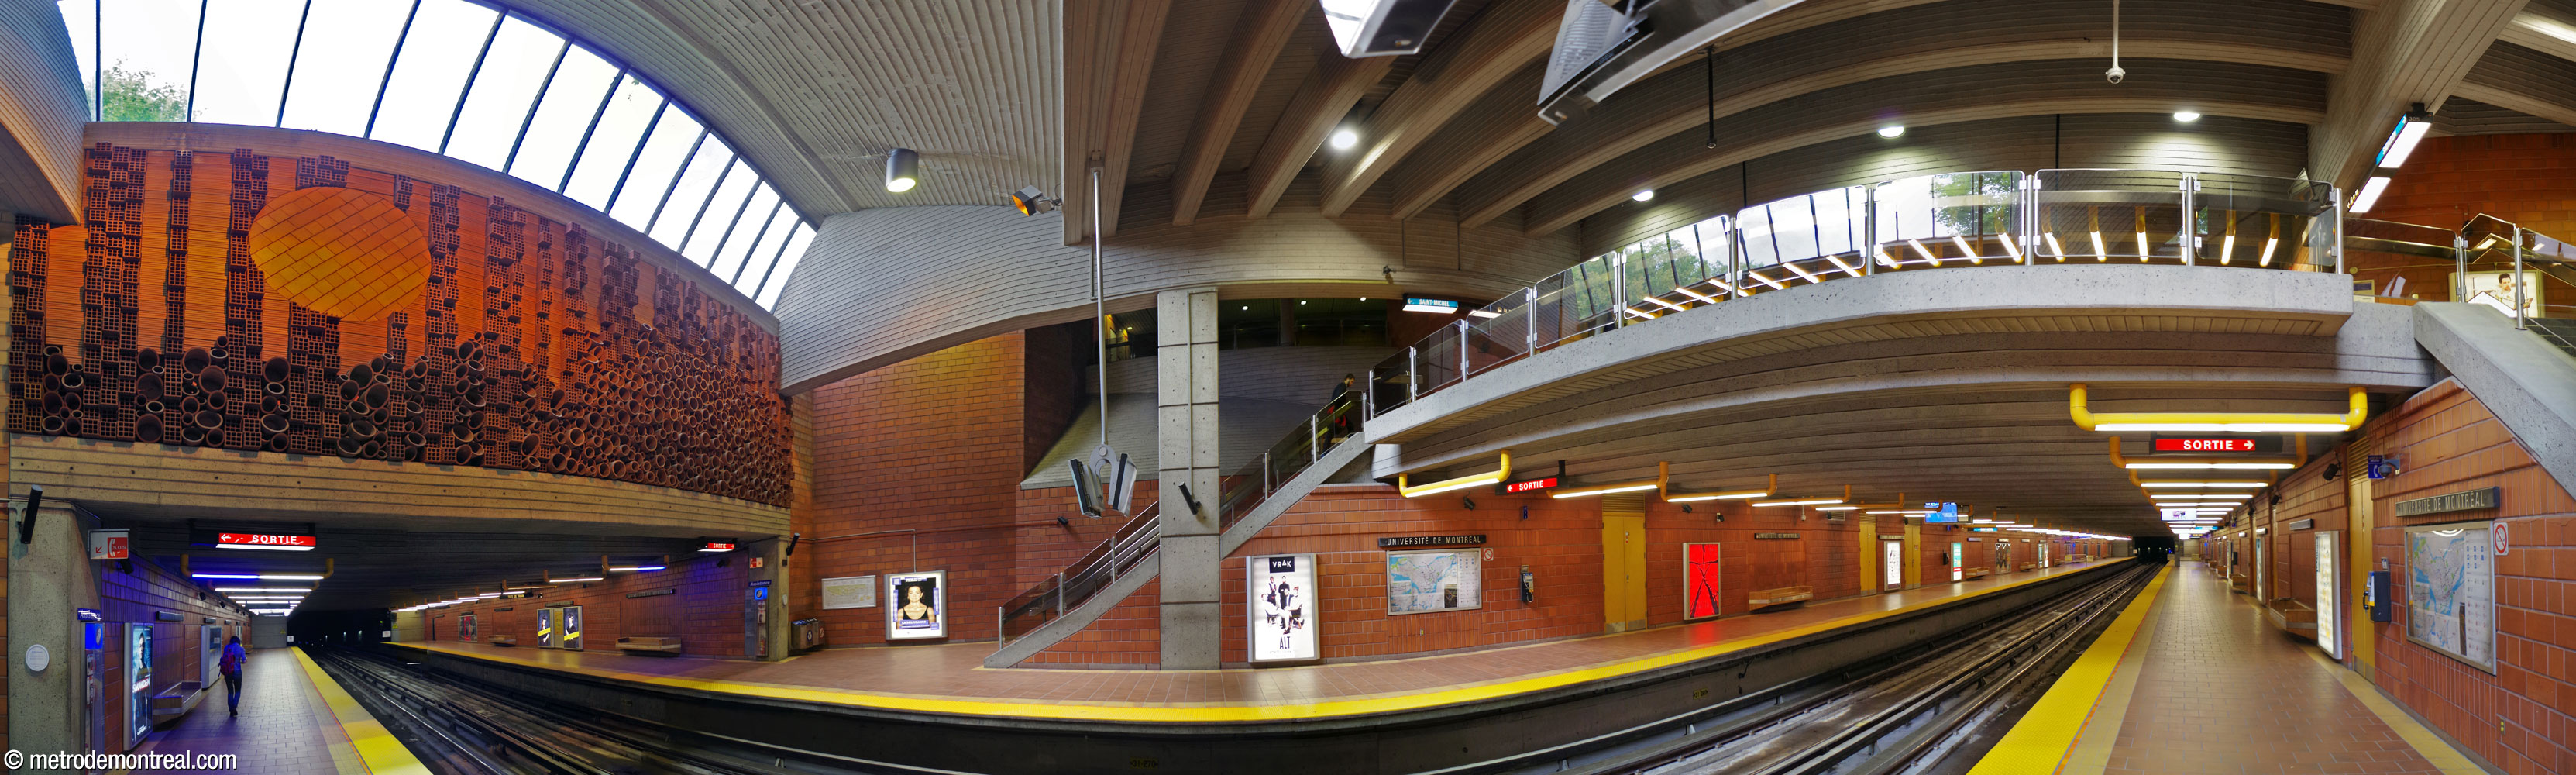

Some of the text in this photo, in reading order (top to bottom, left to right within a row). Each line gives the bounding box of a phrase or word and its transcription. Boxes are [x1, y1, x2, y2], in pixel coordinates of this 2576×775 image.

[2183, 439, 2233, 450] SORTIE
[1518, 480, 1544, 491] SORTIE
[2433, 497, 2441, 511] DE
[252, 534, 297, 544] SORTIE
[1387, 536, 1429, 546] UNIVERSITÉ
[1445, 535, 1481, 544] MONTRÉAL
[1272, 559, 1292, 568] VRAK
[1279, 636, 1291, 649] ALT
